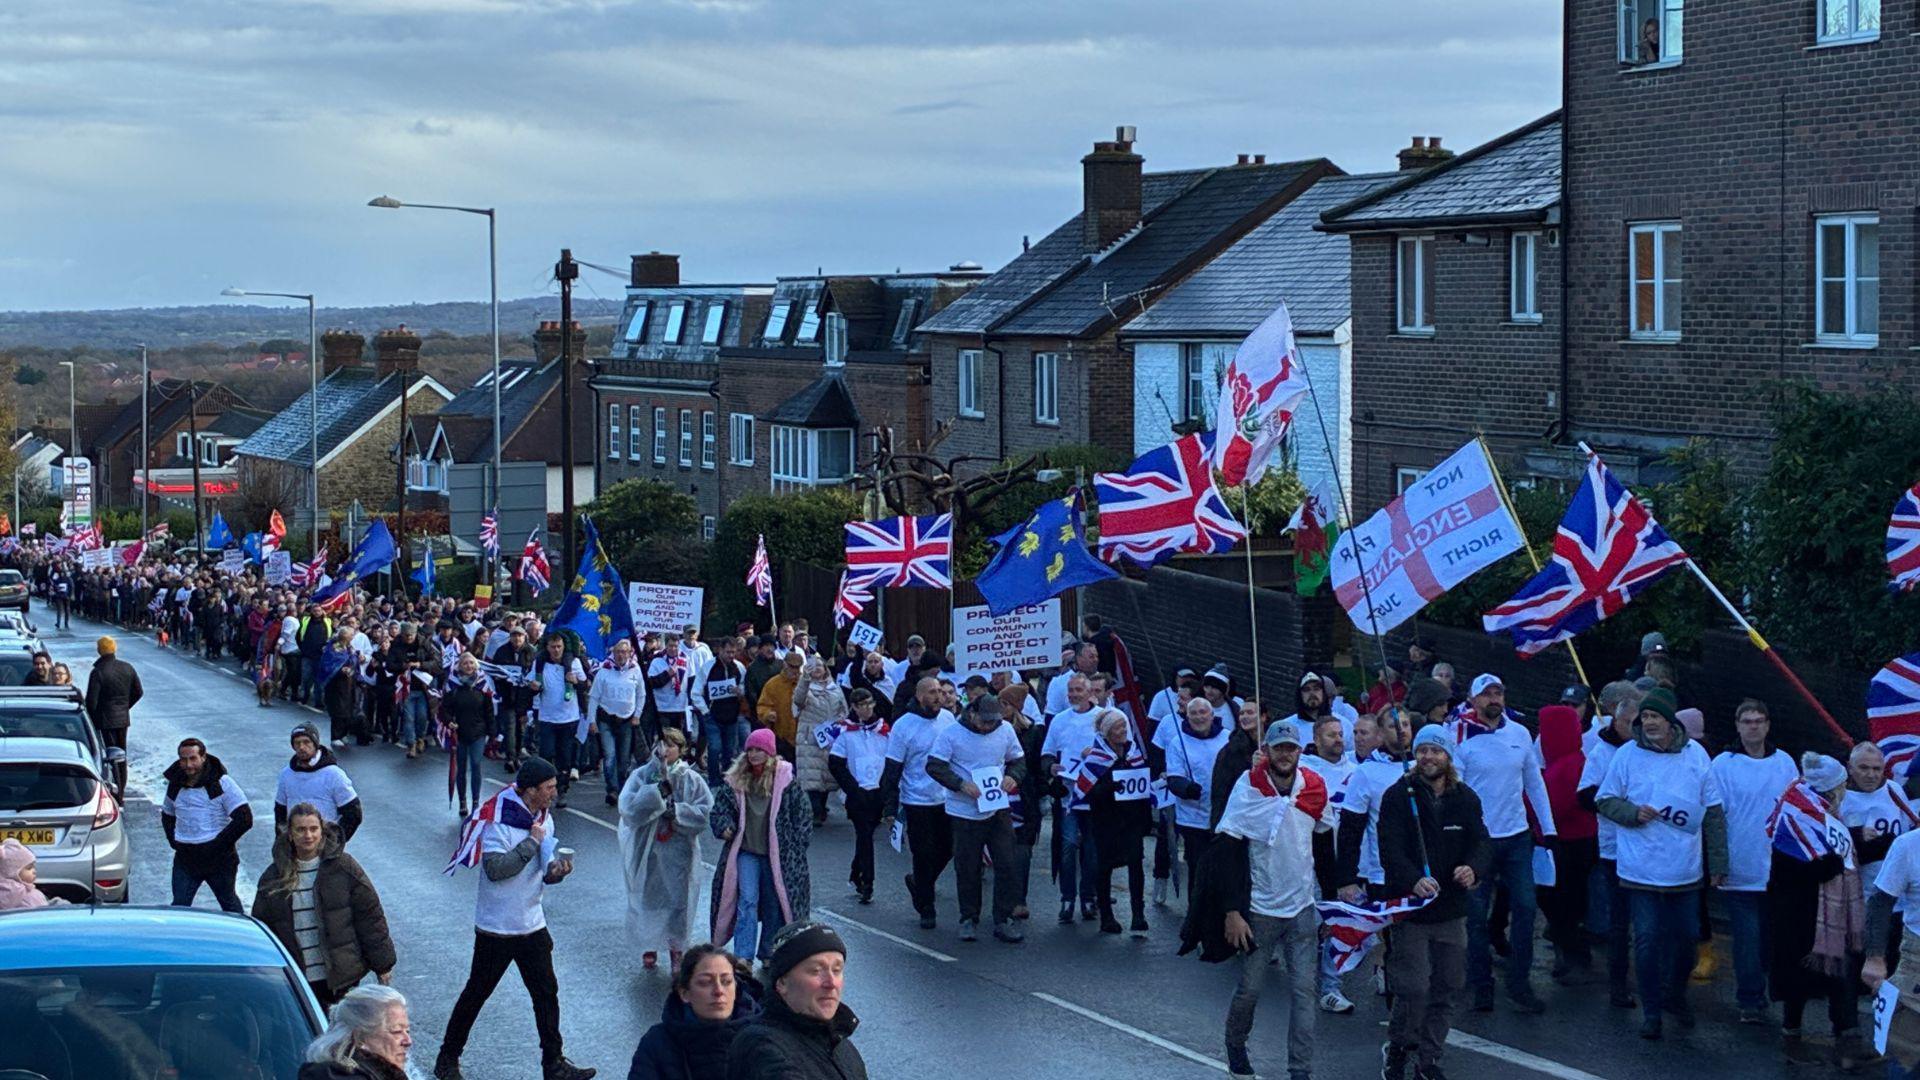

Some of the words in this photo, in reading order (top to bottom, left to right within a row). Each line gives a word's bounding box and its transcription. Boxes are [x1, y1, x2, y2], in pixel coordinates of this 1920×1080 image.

[638, 585, 695, 596] PROTECT
[636, 598, 692, 607] COMMUNITY
[636, 609, 693, 619] PROTECT
[966, 604, 1049, 620] PRECT
[635, 621, 683, 631] FAMILIE
[993, 617, 1021, 625] OUR
[966, 621, 1047, 635] COMMUNITY
[854, 624, 879, 645] 151
[994, 632, 1022, 640] AND
[967, 637, 1049, 653] PROTECT
[995, 650, 1022, 658] OUR
[967, 655, 1049, 671] FAMILIES
[27, 831, 53, 843] XWG
